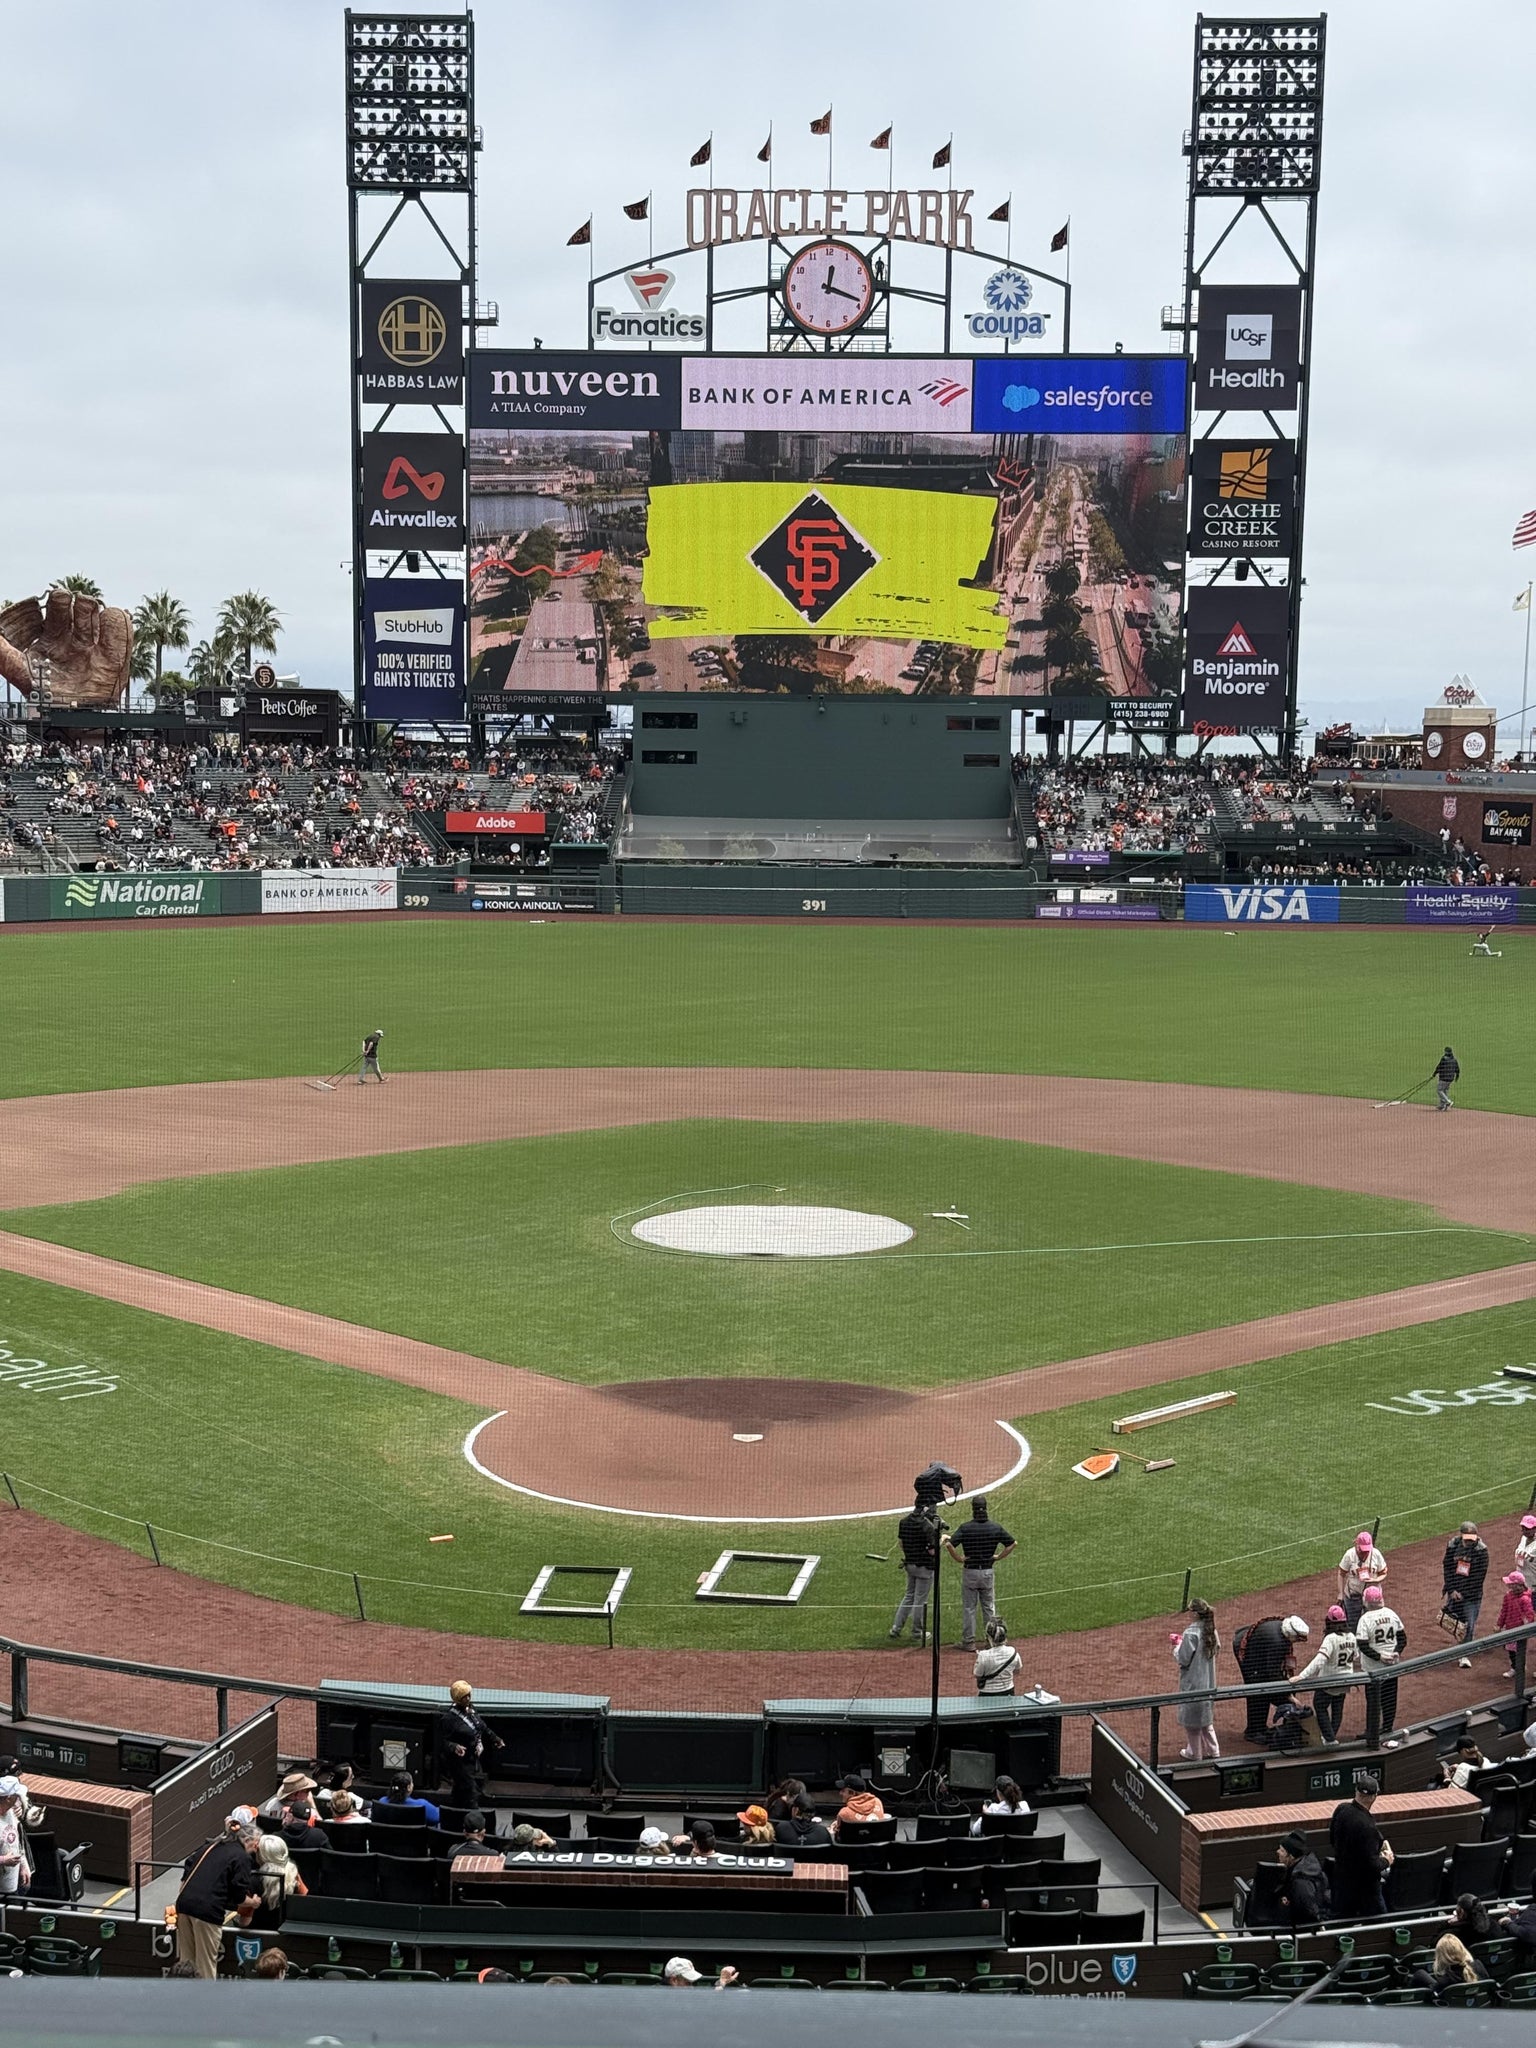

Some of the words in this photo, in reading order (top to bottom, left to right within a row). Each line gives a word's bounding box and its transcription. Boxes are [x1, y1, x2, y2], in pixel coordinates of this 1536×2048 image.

[687, 188, 848, 251] ORACLE
[864, 190, 975, 253] PARK
[597, 311, 703, 336] Fanatics
[972, 316, 1042, 342] coupa
[1231, 328, 1266, 346] UCSF
[366, 374, 424, 389] HABBAS
[430, 376, 458, 389] LAW
[490, 370, 660, 397] nuveen
[1209, 368, 1284, 388] Health
[689, 388, 755, 404] BANK
[763, 388, 793, 404] OF
[800, 388, 912, 405] AMERICA
[1044, 386, 1152, 412] salesforce
[490, 402, 499, 412] A
[502, 402, 531, 413] TIAA
[534, 403, 587, 416] Company
[369, 509, 457, 527] Airwallex
[1203, 504, 1281, 518] CACHE
[1204, 521, 1278, 536] CREEK
[1202, 540, 1240, 548] CASINO
[1242, 540, 1280, 548] RESORT
[787, 519, 848, 606] SF
[384, 620, 443, 633] StubHub
[377, 653, 404, 669] 100%
[407, 654, 452, 669] VERIFIED
[1192, 658, 1279, 680] Benjamin
[374, 672, 410, 687] GIANTS
[412, 672, 456, 688] TICKETS
[502, 695, 547, 704] HAPPENING
[548, 695, 586, 704] BETWEEN
[588, 696, 603, 704] THE
[1444, 685, 1476, 698] Coors
[260, 698, 286, 715] Peet's
[287, 699, 318, 718] Coffee
[472, 703, 508, 712] PIRATES
[1446, 697, 1473, 705] LIGHT
[1113, 710, 1133, 719] (415)
[1193, 720, 1238, 736] Coors
[1239, 725, 1278, 736] LIGHT
[475, 816, 516, 828] Adobe
[1498, 810, 1531, 828] Sports
[1489, 827, 1503, 836] BAY
[1504, 828, 1522, 837] AREA
[100, 880, 204, 903] National
[266, 889, 297, 899] BANK
[300, 888, 314, 898] OF
[317, 887, 368, 898] AMERICA
[404, 895, 430, 906] 399
[484, 900, 520, 910] KONICA
[522, 901, 562, 910] MINOLTA
[802, 899, 826, 911] 391
[1213, 888, 1310, 920] VISA
[135, 904, 157, 916] Car
[159, 902, 200, 915] Rental
[1374, 1626, 1395, 1643] 24
[1338, 1651, 1354, 1667] 24
[33, 1747, 42, 1756] 121
[59, 1750, 73, 1763] 117
[1324, 1774, 1340, 1788] 113
[189, 1791, 207, 1812] Audi
[208, 1772, 235, 1798] Dugout
[512, 1851, 583, 1864] Audi
[593, 1853, 708, 1867] Dugout
[717, 1855, 787, 1868] Club
[1026, 1953, 1102, 1986] blue
